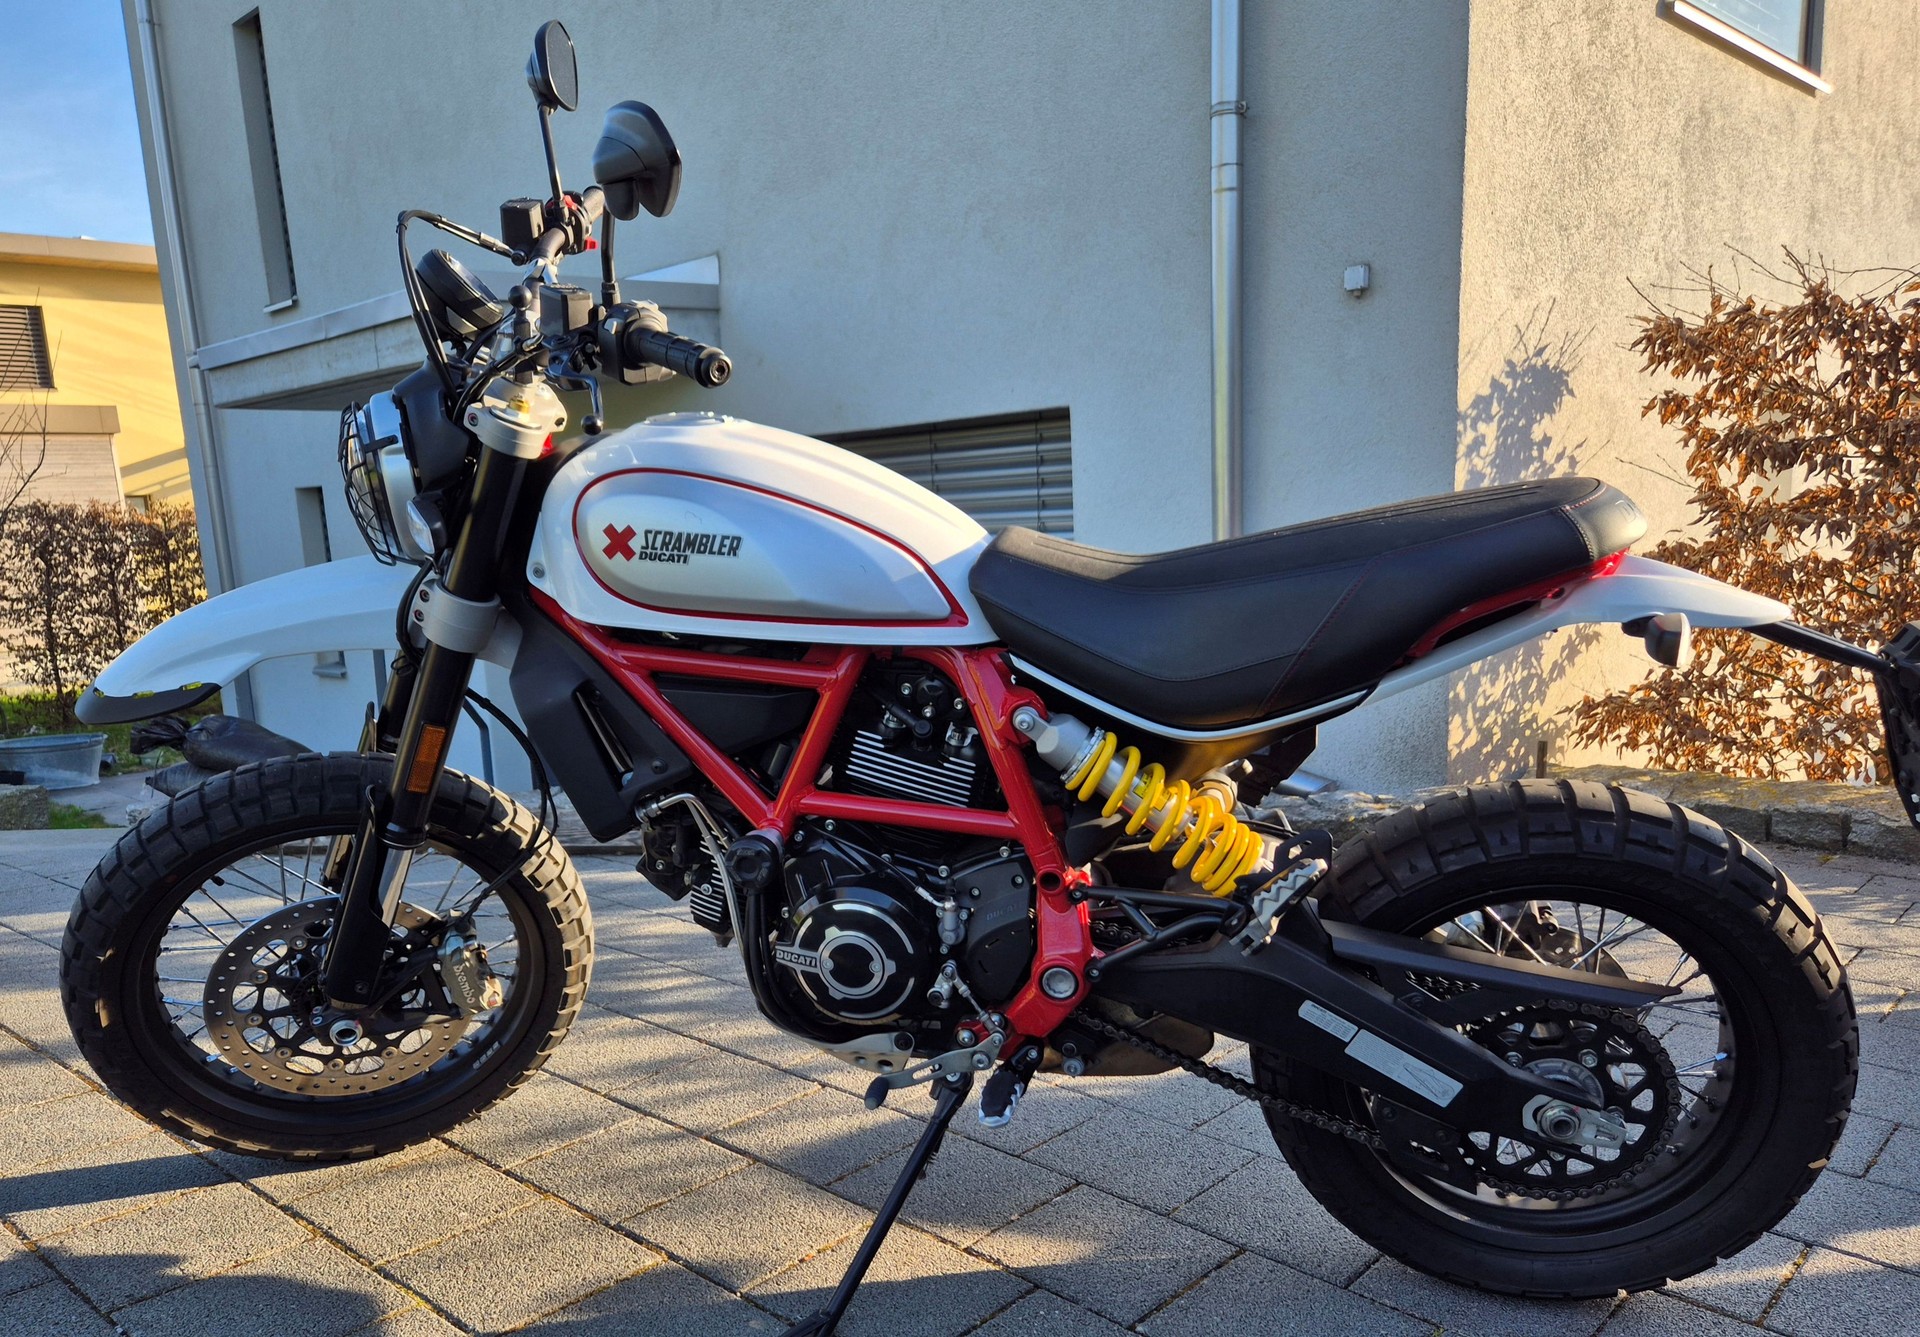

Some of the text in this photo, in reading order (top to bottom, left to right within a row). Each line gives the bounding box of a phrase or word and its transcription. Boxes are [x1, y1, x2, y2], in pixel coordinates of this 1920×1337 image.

[640, 529, 742, 557] SCRAMBLER
[638, 551, 689, 564] DUCATI
[986, 902, 1021, 921] DUCAT
[776, 950, 816, 967] DUCATI
[453, 963, 476, 1004] brembo
